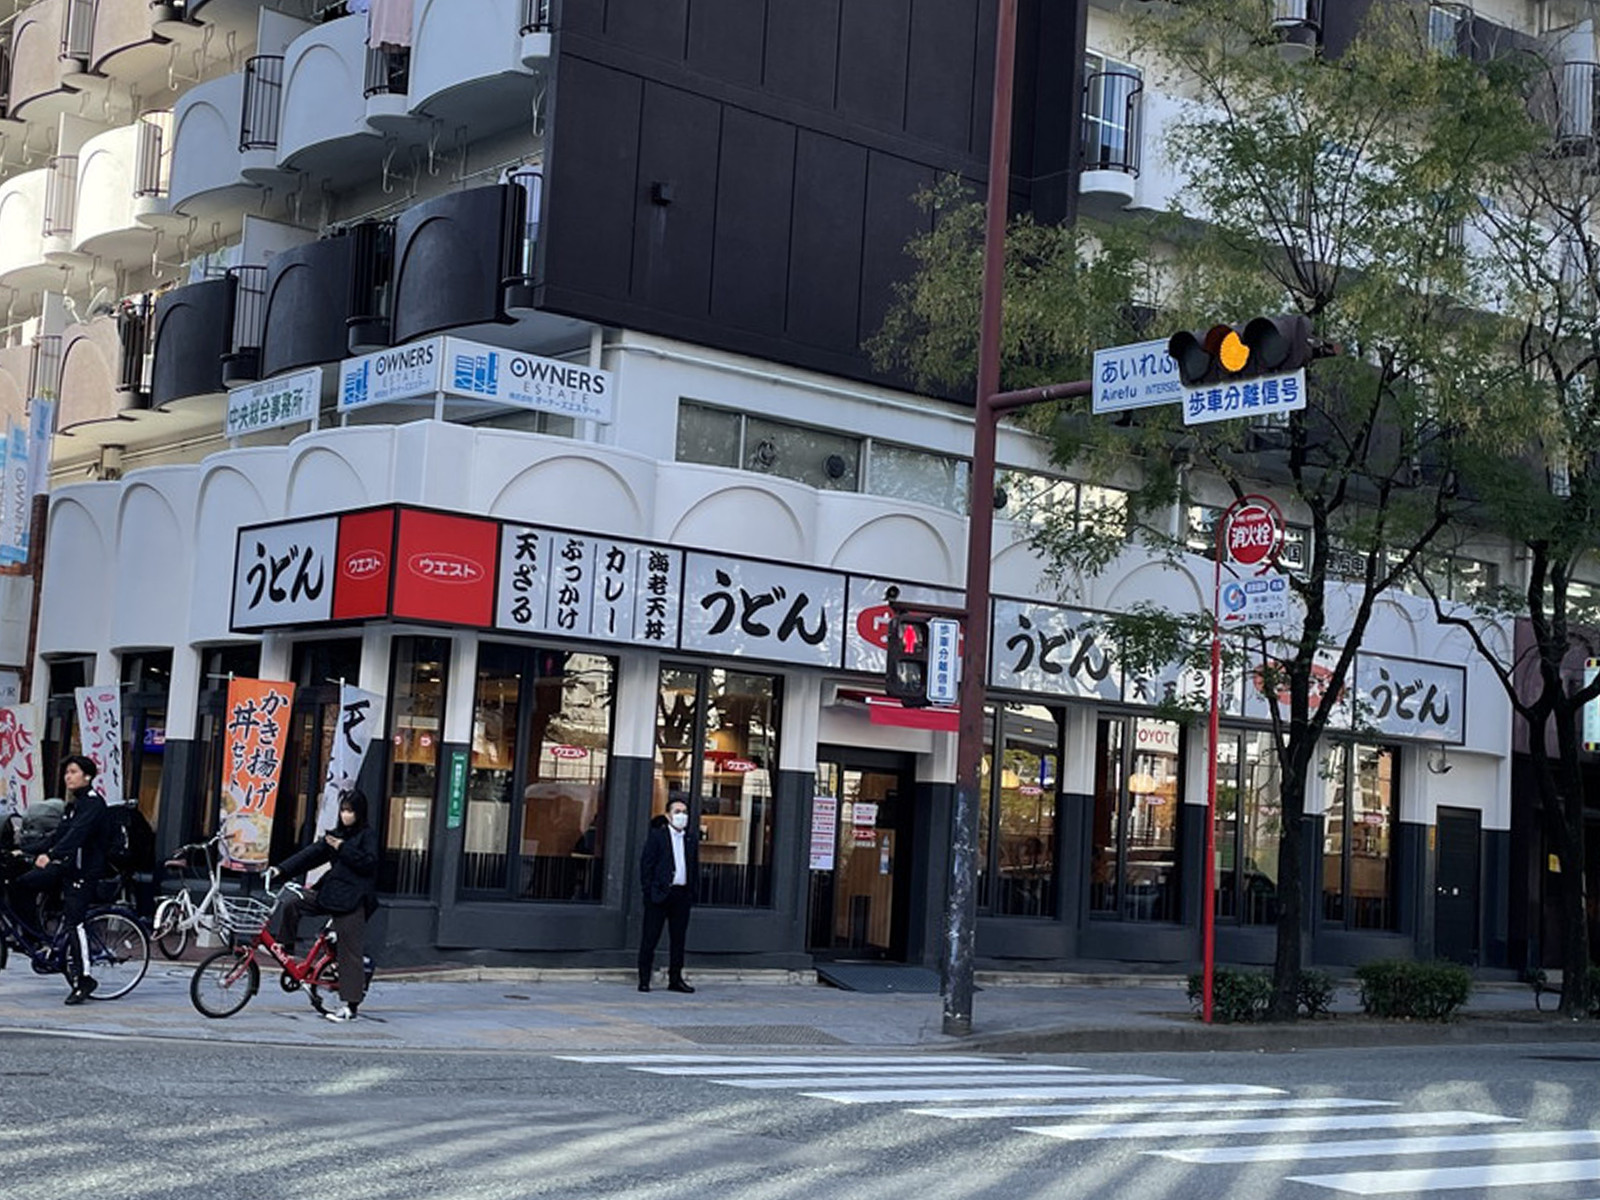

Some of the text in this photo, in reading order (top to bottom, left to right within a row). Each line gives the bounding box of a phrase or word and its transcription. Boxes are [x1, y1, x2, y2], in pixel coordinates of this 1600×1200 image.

[376, 344, 434, 376] OWNERS
[382, 367, 423, 388] ESTATE
[510, 357, 605, 395] OWNERS
[229, 388, 303, 430] 中央総合事務所
[523, 381, 590, 404] ESTATE
[1188, 377, 1299, 417] 歩車分離信号
[1231, 523, 1271, 549] 消火栓
[246, 541, 325, 610] うどん
[348, 557, 381, 574] ウエスト
[418, 557, 477, 578] ウエスト
[511, 533, 539, 624] 天ざる
[557, 539, 585, 630] ぶっかけ
[644, 551, 669, 641] 海老天丼
[700, 569, 828, 645] うどん
[1006, 614, 1111, 682] うどん
[1370, 667, 1450, 725] うどん
[247, 690, 289, 809] かき揚げ
